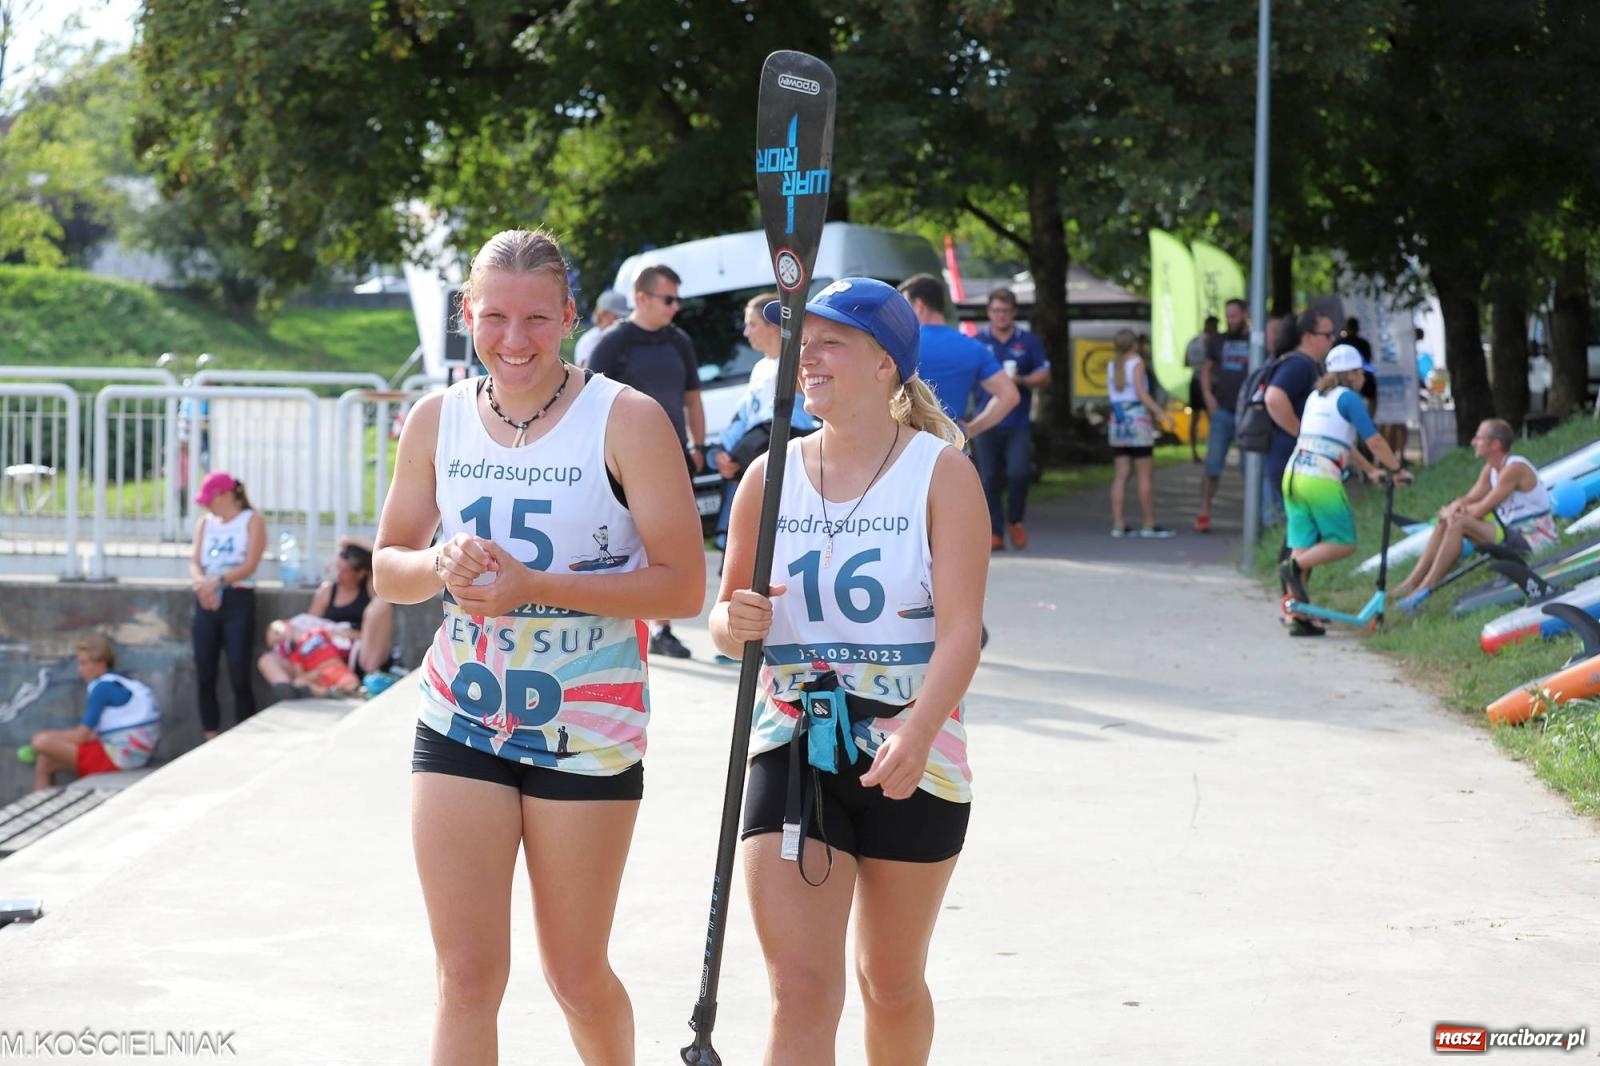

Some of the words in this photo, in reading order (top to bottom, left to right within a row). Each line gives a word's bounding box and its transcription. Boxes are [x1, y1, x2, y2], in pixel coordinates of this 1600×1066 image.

[448, 458, 583, 487] #odrasupcup
[459, 496, 554, 572] 15
[776, 514, 909, 537] #odrasupcup
[787, 548, 886, 624] 16
[533, 627, 605, 654] SUP
[450, 662, 562, 727] OD
[873, 674, 927, 700] SU
